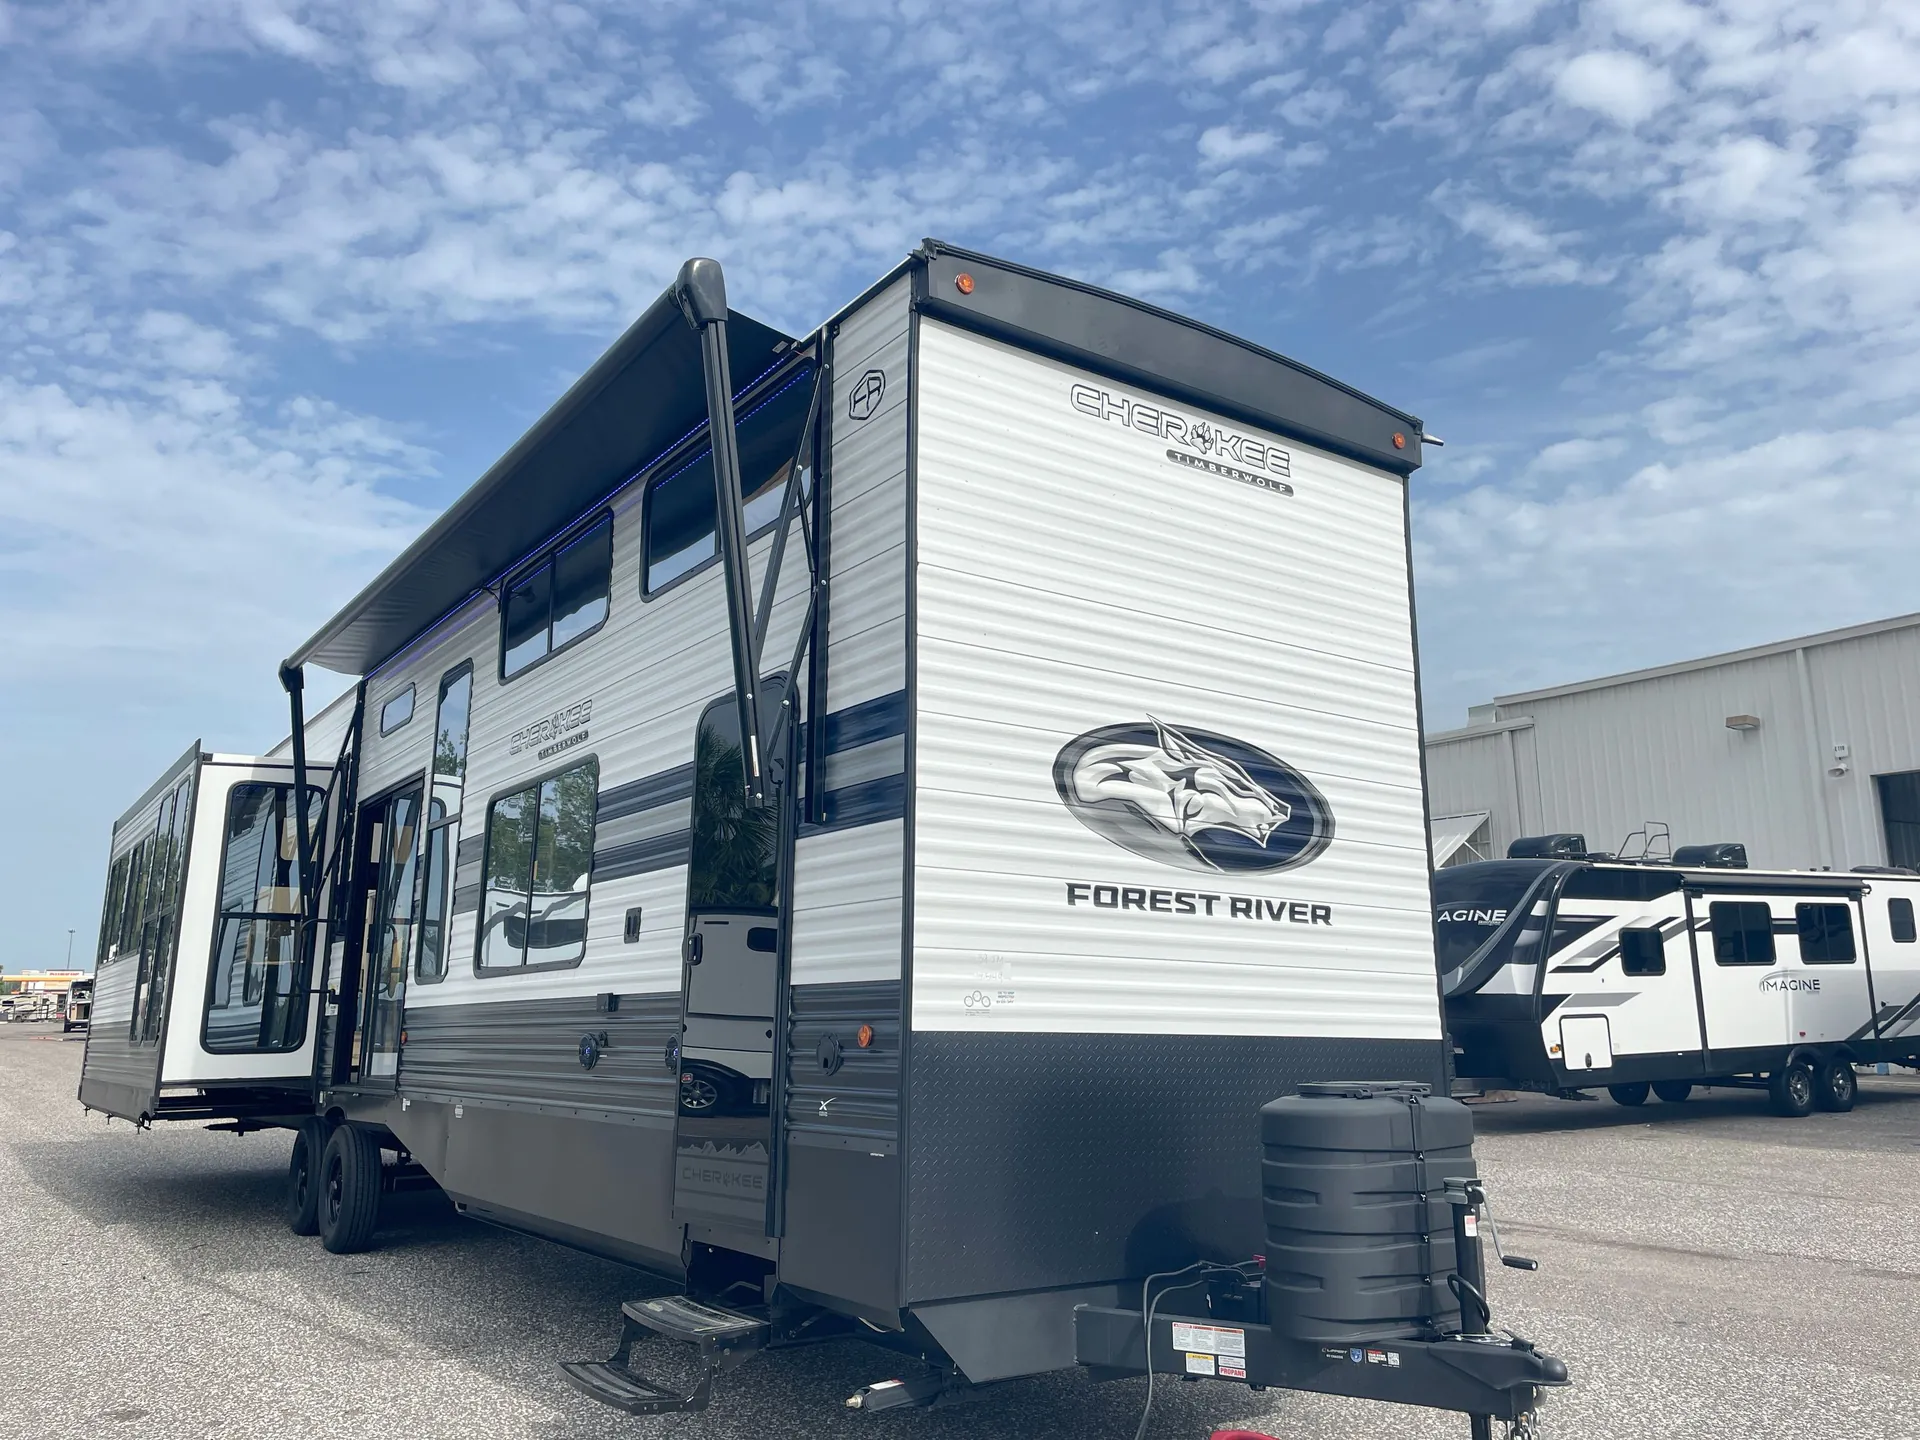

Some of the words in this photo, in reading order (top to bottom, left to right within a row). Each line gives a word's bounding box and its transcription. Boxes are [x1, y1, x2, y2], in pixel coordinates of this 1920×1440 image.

[1071, 383, 1291, 477] CHEROKEE
[1174, 451, 1287, 493] TIMBERWOLF
[1065, 882, 1221, 917] FOREST
[1228, 896, 1333, 927] RIVER
[1437, 909, 1508, 923] AGINE
[1761, 979, 1821, 991] IMAGINE
[1219, 1367, 1245, 1378] PROPANE
